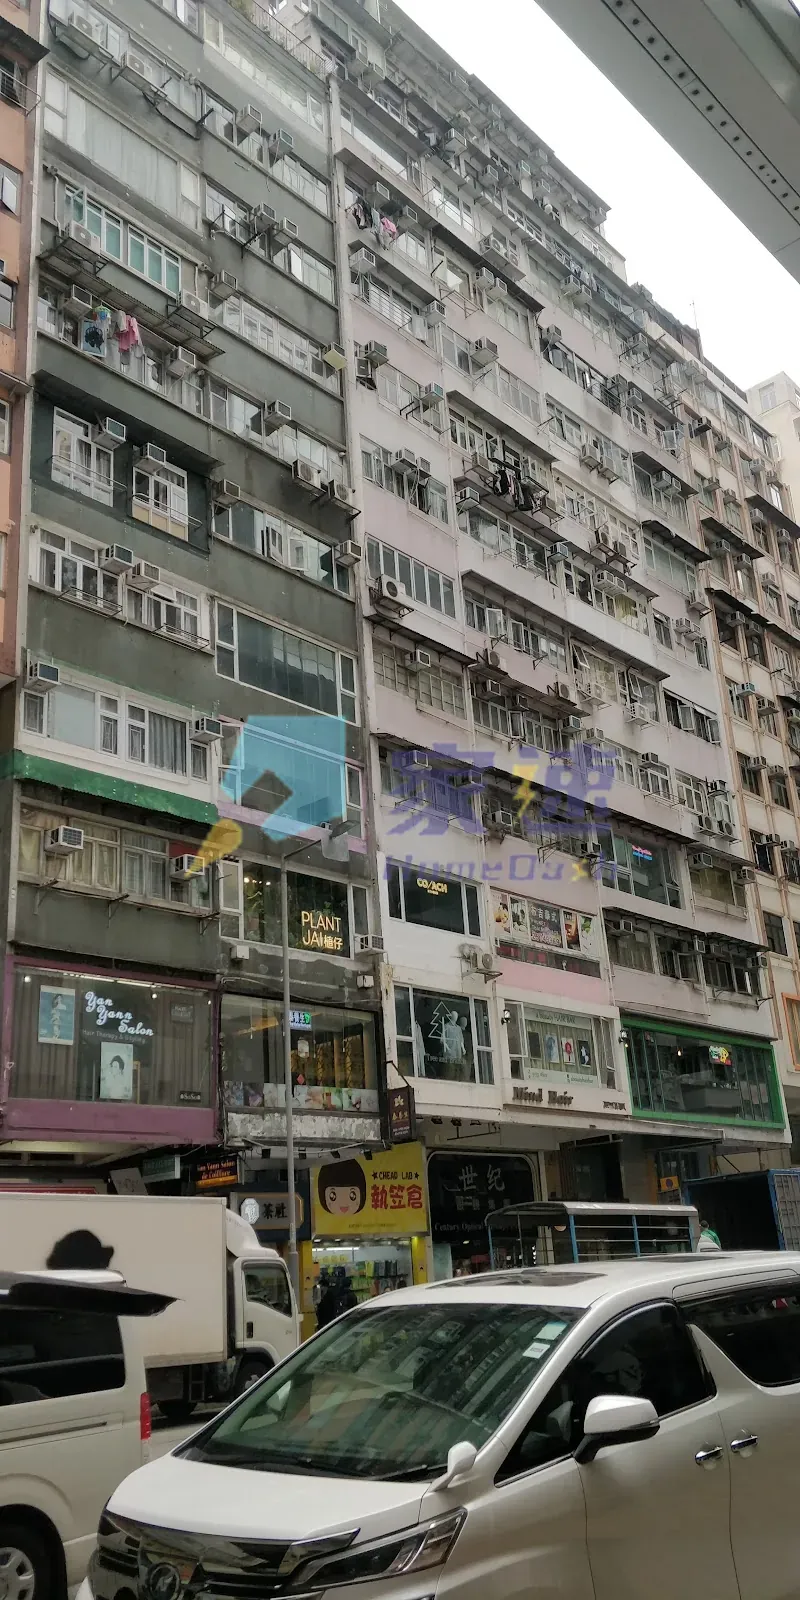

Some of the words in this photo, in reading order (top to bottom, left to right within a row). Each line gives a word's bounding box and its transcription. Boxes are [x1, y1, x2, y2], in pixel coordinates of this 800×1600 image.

[301, 911, 341, 932] PLANT
[302, 930, 323, 947] JAI
[85, 991, 113, 1012] Yan
[96, 1006, 133, 1025] Yann
[118, 1020, 154, 1036] Salon
